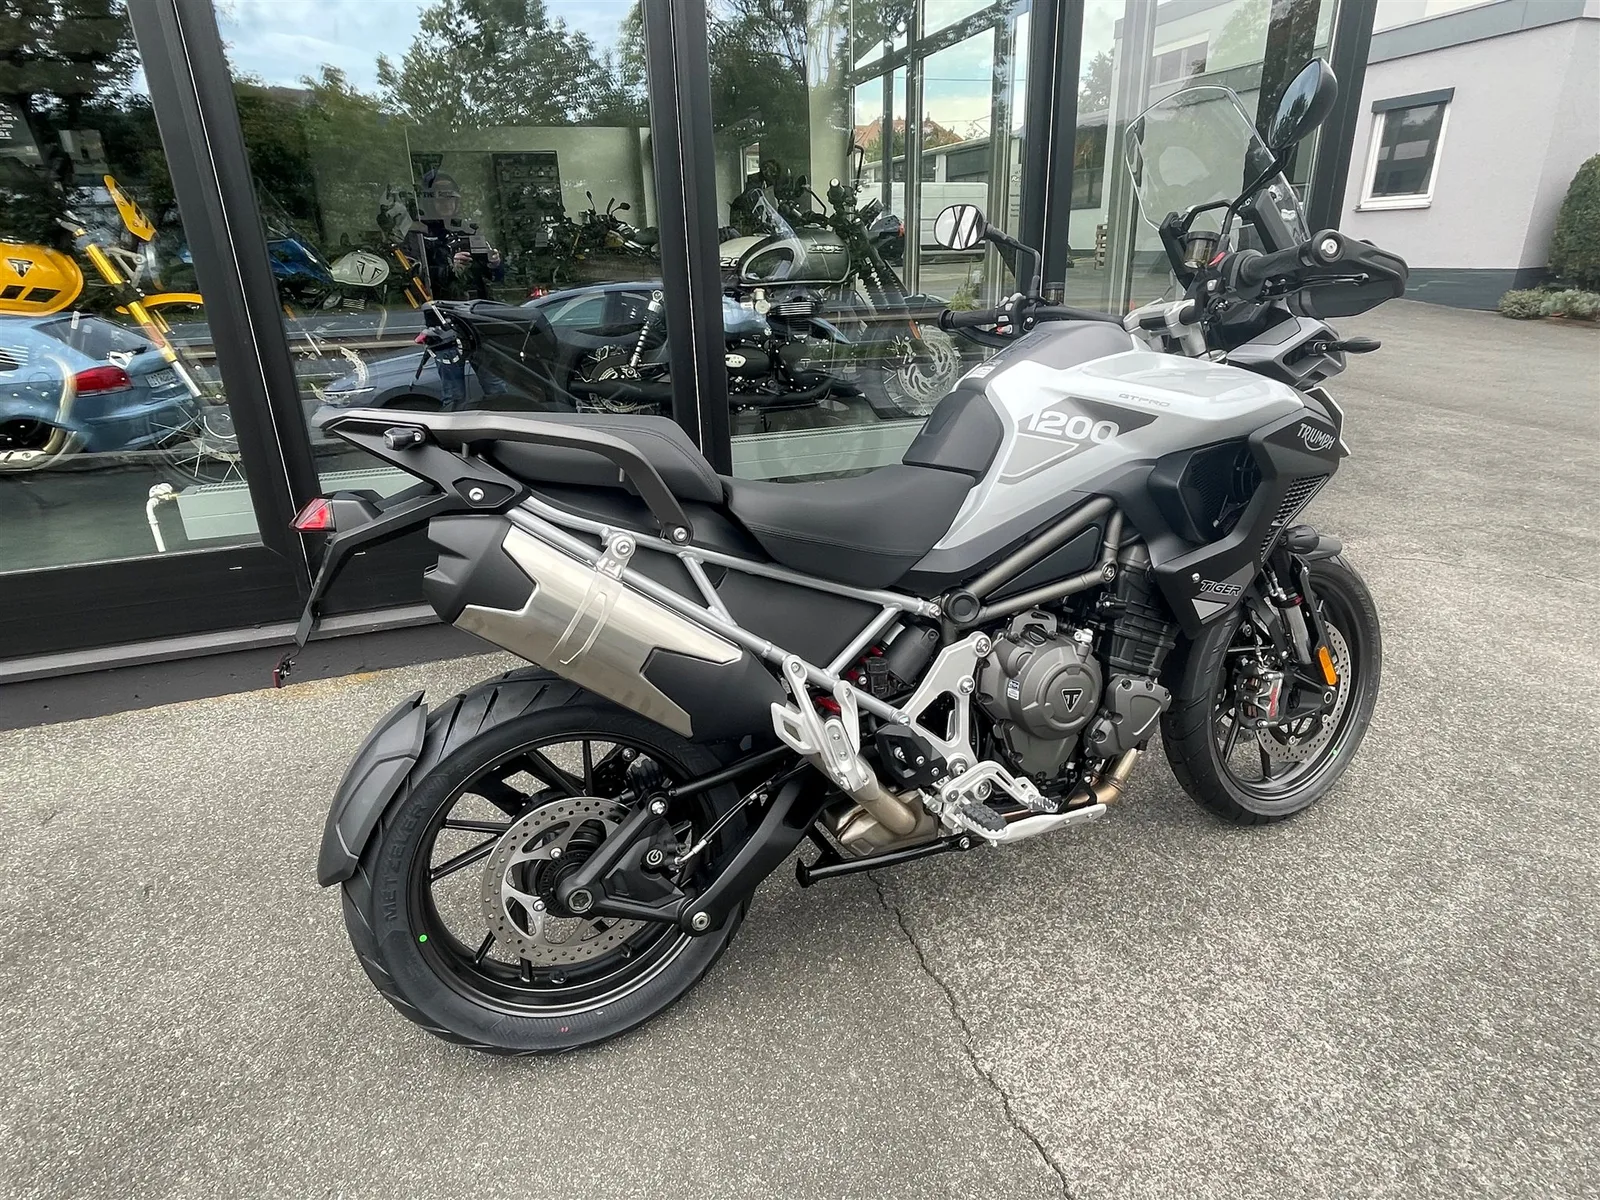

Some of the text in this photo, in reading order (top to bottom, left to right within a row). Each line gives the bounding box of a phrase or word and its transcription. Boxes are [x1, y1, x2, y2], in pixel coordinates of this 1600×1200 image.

[1028, 409, 1120, 444] 1200
[1297, 422, 1336, 450] TRIUMPH
[1200, 579, 1243, 597] TIGER
